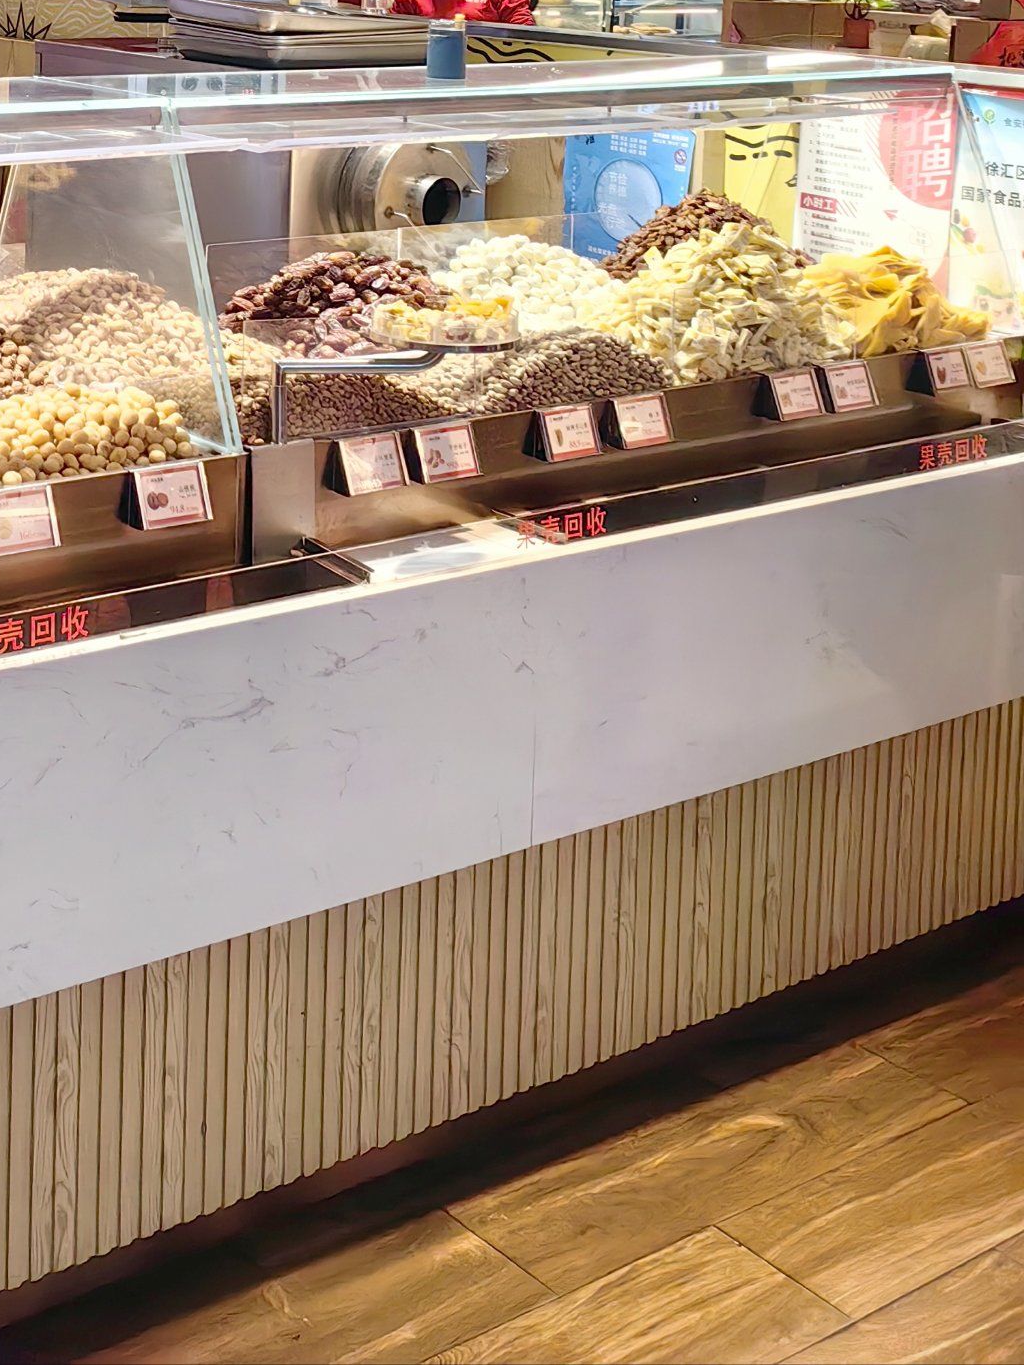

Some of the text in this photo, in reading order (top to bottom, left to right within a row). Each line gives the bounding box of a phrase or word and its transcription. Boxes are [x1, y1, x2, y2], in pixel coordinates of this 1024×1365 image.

[961, 185, 1024, 209] 国家食品
[918, 434, 988, 471] 果壳回收
[516, 506, 608, 549] 果壳回收
